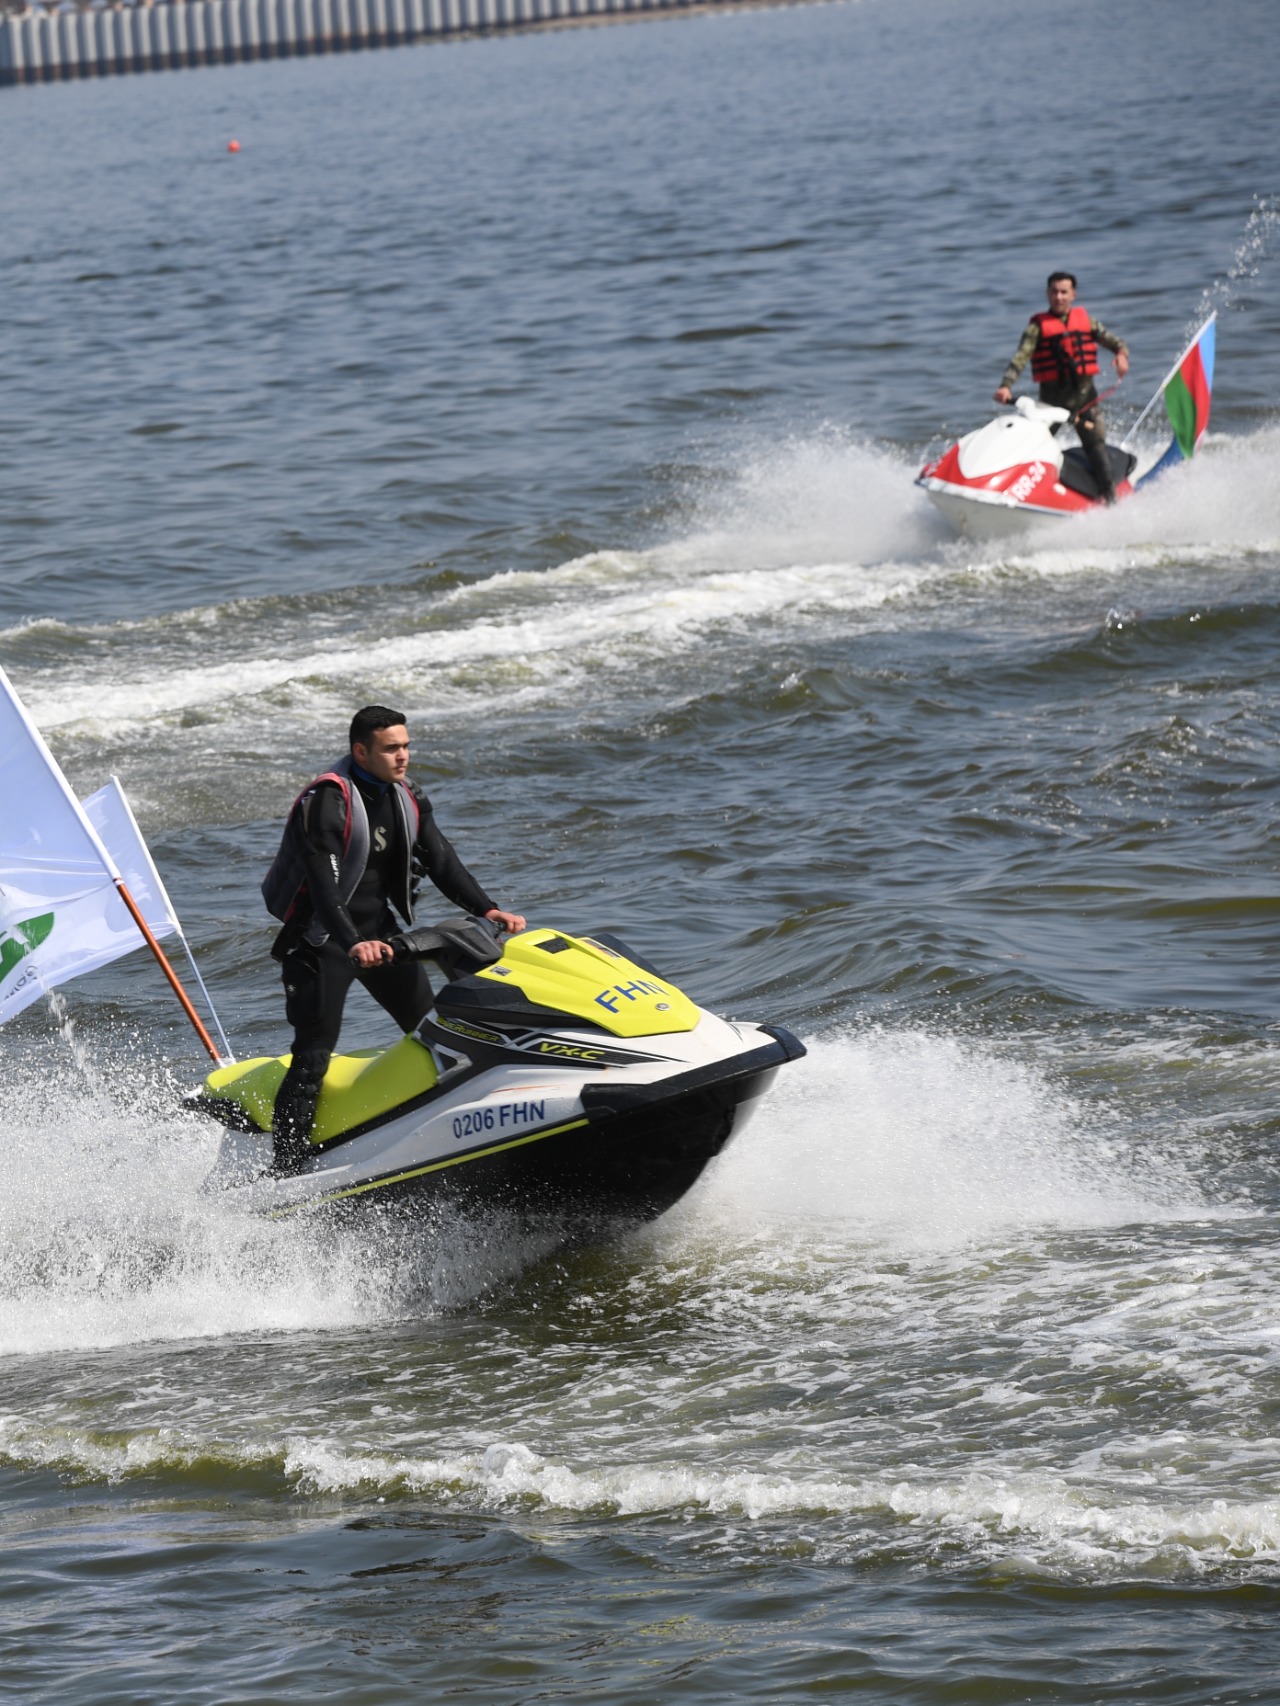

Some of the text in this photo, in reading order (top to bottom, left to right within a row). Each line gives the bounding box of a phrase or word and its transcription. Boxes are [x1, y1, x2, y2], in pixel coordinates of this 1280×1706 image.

[374, 826, 387, 851] S
[595, 980, 670, 1014] FHN
[453, 1099, 545, 1139] 0206 FHN
